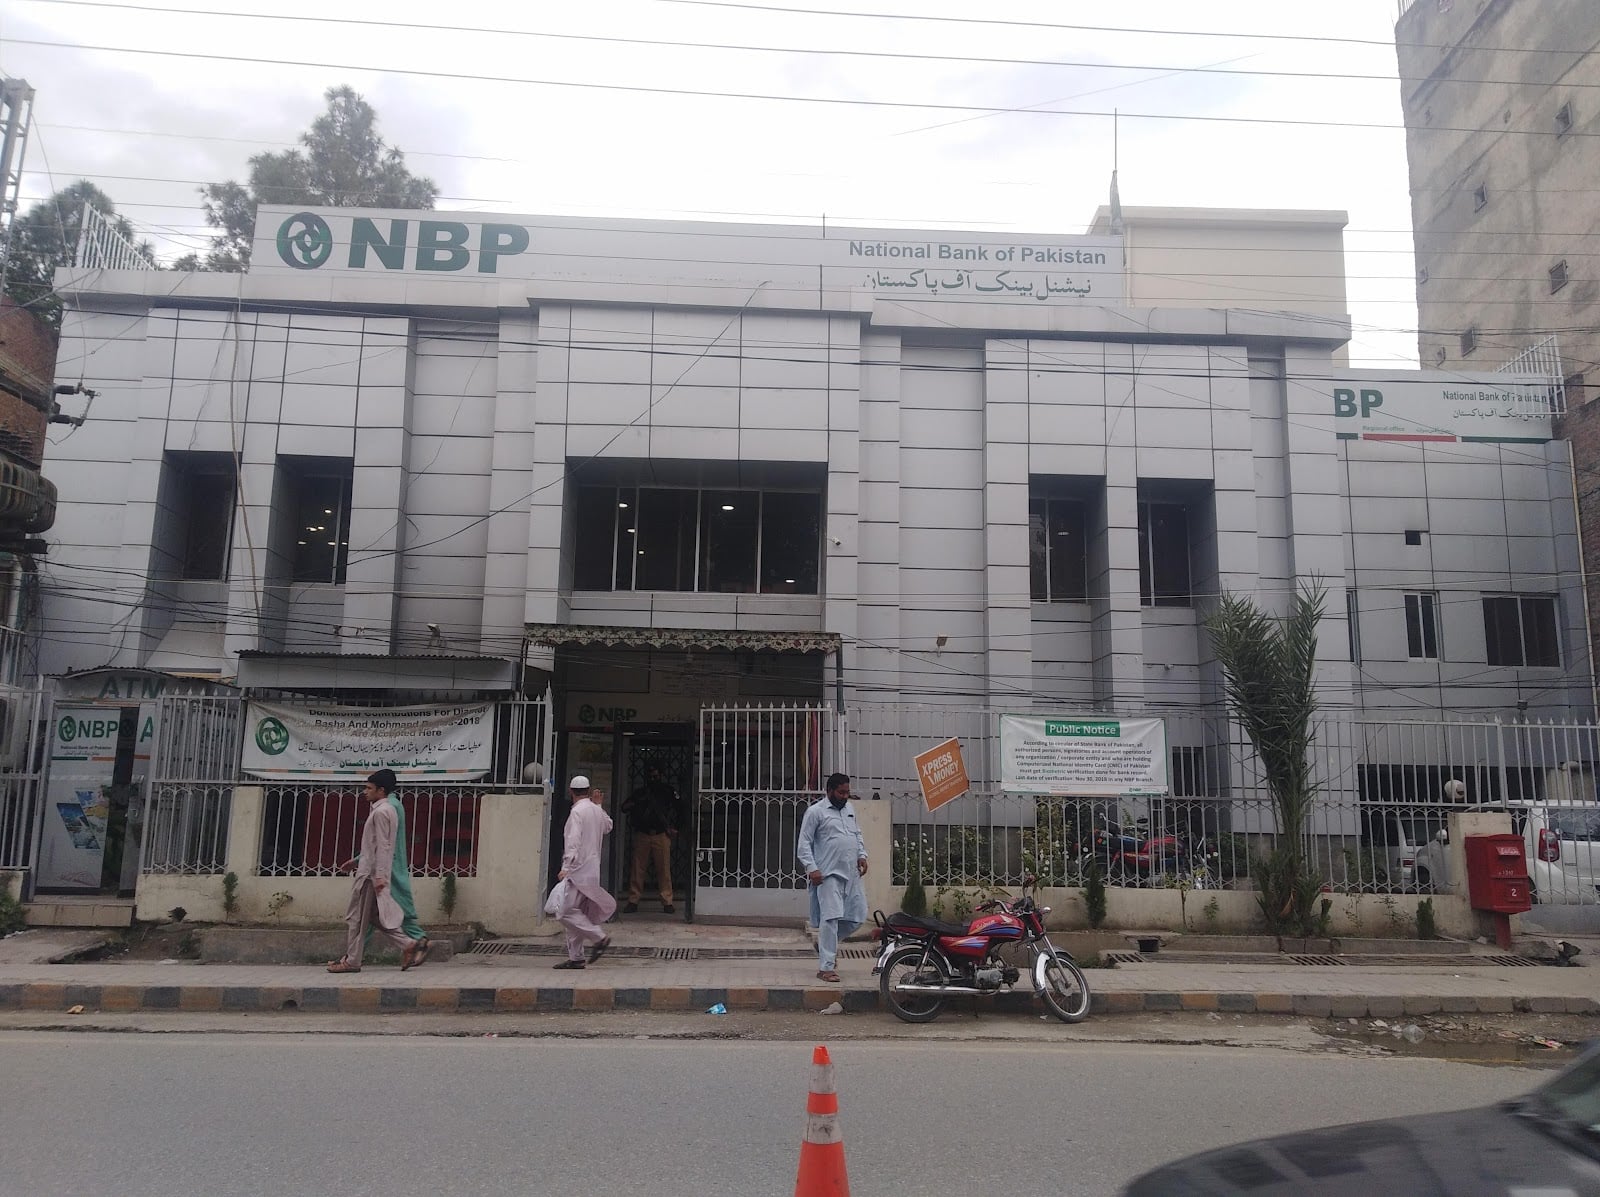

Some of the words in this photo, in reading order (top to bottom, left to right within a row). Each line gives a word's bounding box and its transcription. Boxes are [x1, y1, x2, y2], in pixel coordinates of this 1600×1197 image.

[348, 218, 529, 273] NBP
[849, 241, 931, 259] National
[938, 244, 988, 261] Bank
[995, 246, 1015, 262] of
[1021, 247, 1106, 265] Pakistan
[941, 269, 973, 288] آف
[975, 270, 1033, 296] بینک
[1036, 274, 1091, 300] نیشنل
[1443, 390, 1477, 401] National
[1479, 391, 1499, 401] Bank
[1502, 392, 1510, 402] of
[99, 676, 165, 699] ATM
[434, 709, 449, 717] For
[599, 708, 637, 722] NBP
[78, 720, 118, 738] NBP
[315, 719, 345, 728] Basha
[348, 720, 368, 729] And
[371, 720, 419, 730] Mohmand
[1049, 724, 1081, 734] Public
[1083, 725, 1116, 734] Notice
[419, 729, 442, 737] Here
[339, 758, 370, 769] پاکستان
[371, 757, 383, 767] آف
[387, 759, 410, 768] بینک
[412, 758, 437, 768] نیشنل
[922, 751, 953, 777] XPRESS
[934, 760, 959, 785] MONEY
[1511, 888, 1517, 897] 2
